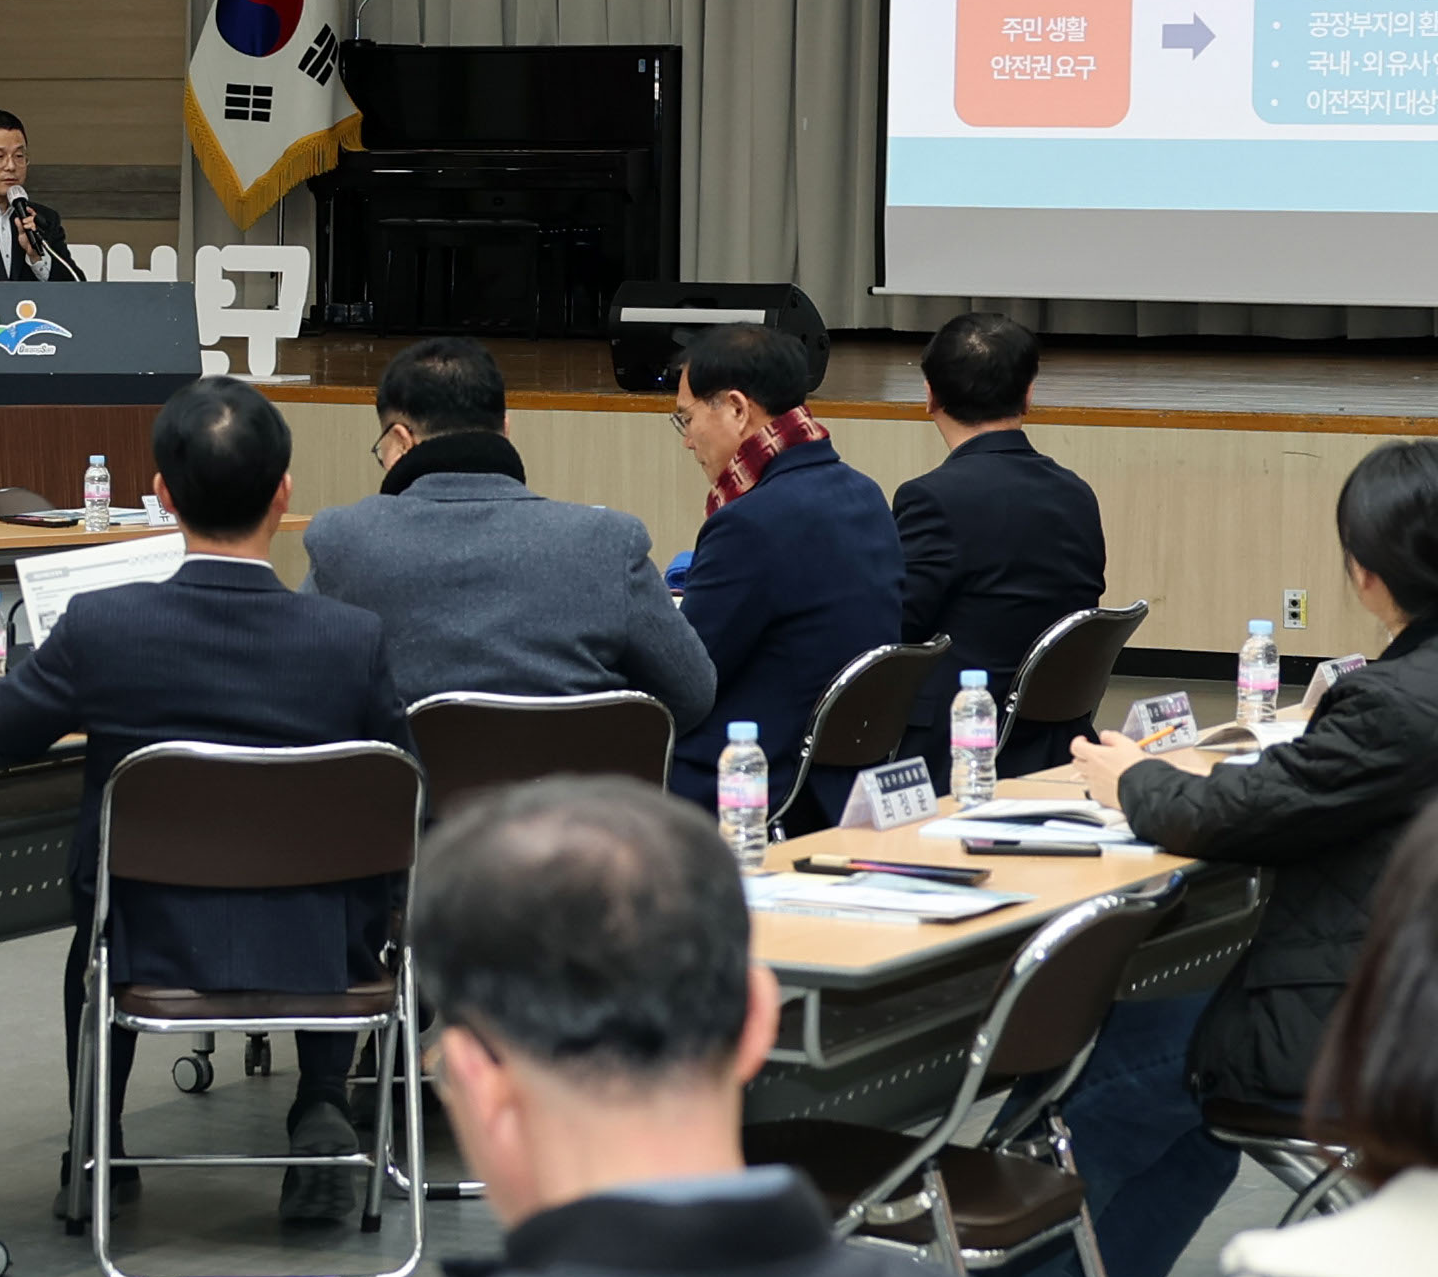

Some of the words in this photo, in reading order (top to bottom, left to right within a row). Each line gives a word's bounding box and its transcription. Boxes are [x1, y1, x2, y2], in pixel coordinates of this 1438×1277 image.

[1001, 15, 1042, 42] 주민
[1045, 15, 1087, 42] 생활
[1308, 10, 1415, 38] 공장부지의
[990, 54, 1051, 80] 안전권
[1053, 55, 1096, 80] 요구
[1385, 49, 1431, 77] 유사
[1306, 88, 1391, 116] 이전적지
[1394, 88, 1438, 116] 대상
